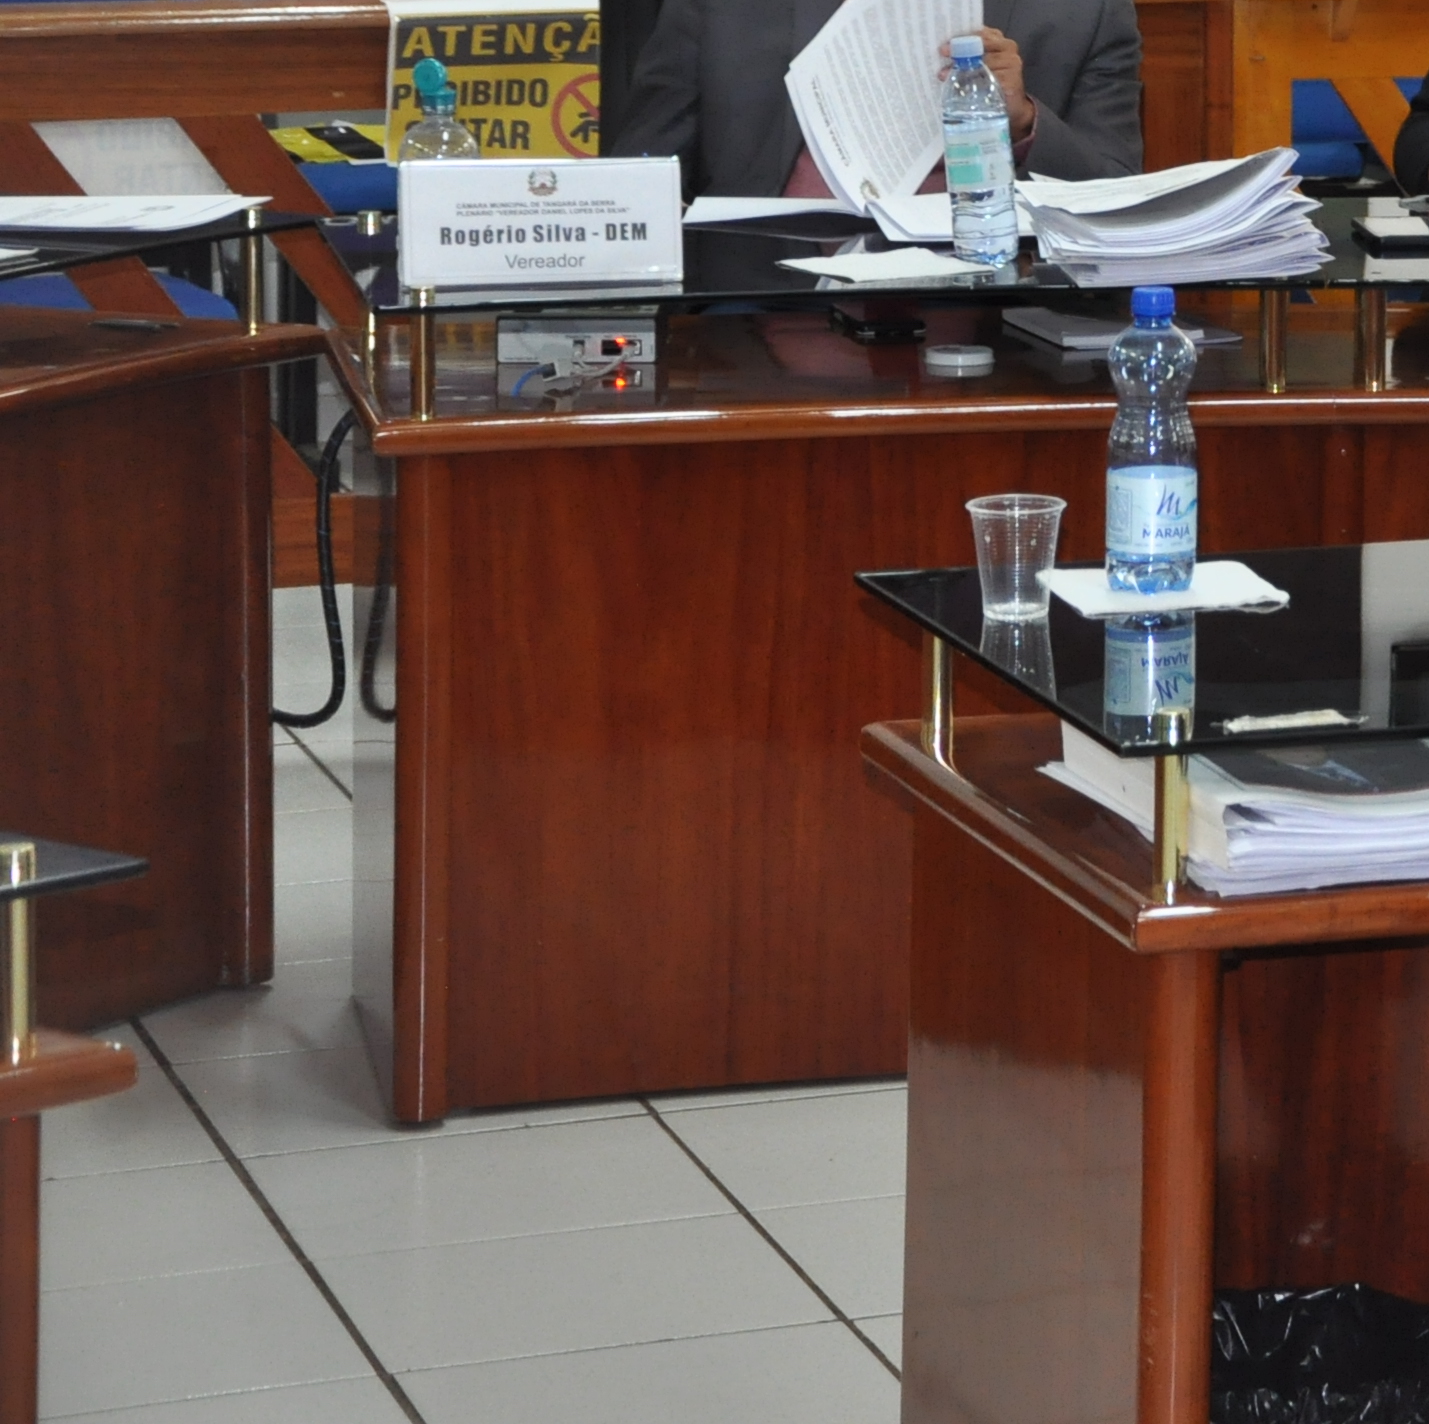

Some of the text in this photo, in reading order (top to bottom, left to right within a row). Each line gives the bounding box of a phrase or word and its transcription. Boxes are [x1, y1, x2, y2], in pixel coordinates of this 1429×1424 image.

[440, 224, 527, 247] Rogério
[532, 224, 586, 243] Silva
[605, 223, 648, 242] DEM
[505, 253, 586, 269] Vereador
